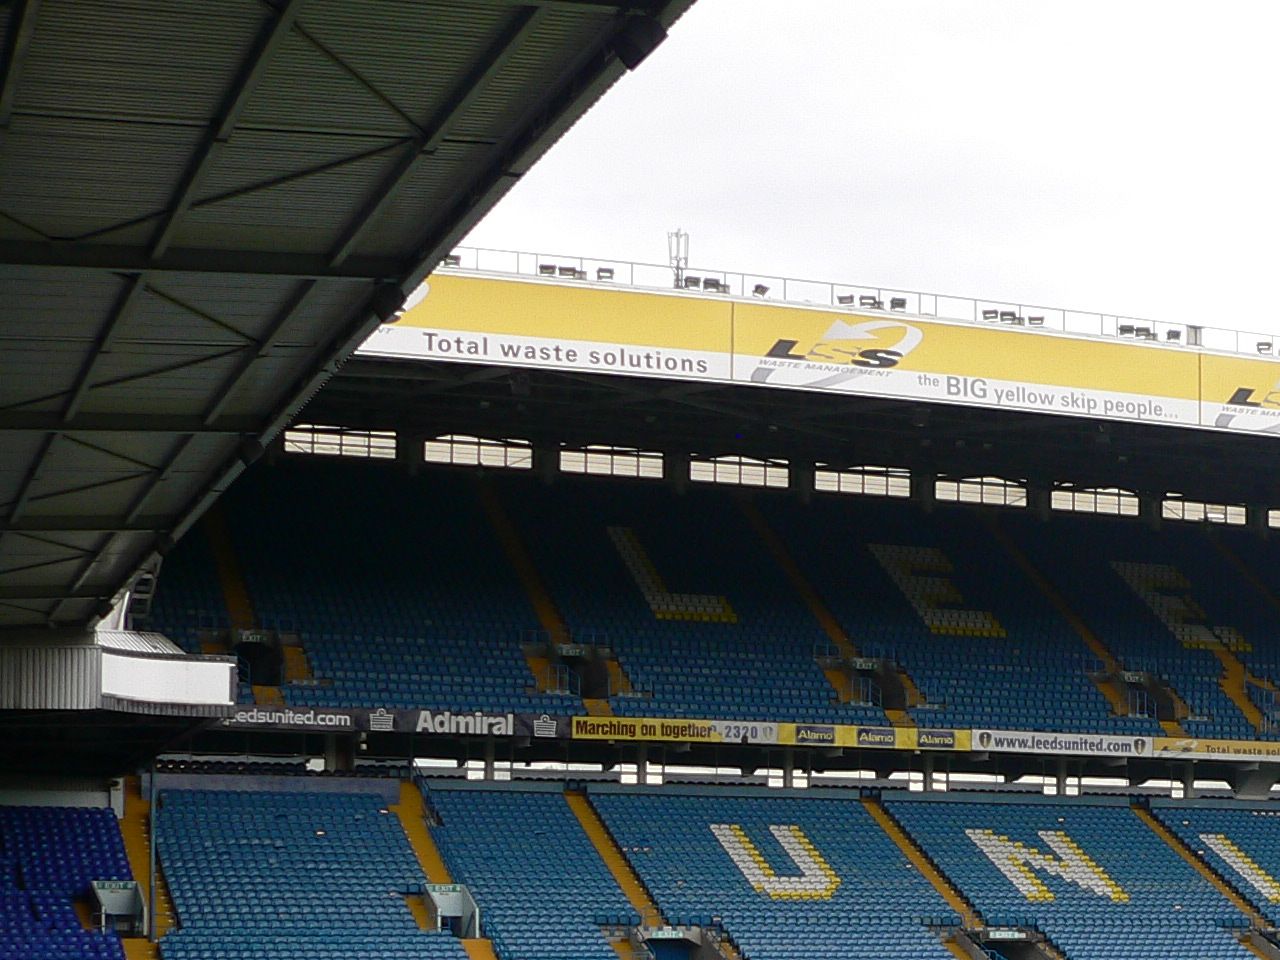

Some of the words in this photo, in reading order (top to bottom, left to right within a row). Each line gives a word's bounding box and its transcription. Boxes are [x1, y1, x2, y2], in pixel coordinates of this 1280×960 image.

[422, 332, 488, 356] Total
[500, 342, 578, 363] waste
[589, 349, 708, 373] solutions
[758, 359, 803, 369] WASTE
[805, 362, 893, 378] MANAGEMENT
[917, 374, 940, 388] the
[947, 376, 987, 399] BIG
[994, 386, 1055, 406] yellow
[1060, 391, 1098, 413] skip
[1221, 405, 1258, 415] WASTE
[232, 708, 350, 727] edsunited.com
[416, 709, 514, 736] Admiral
[575, 719, 636, 738] Marching
[641, 723, 657, 737] on
[661, 721, 712, 740] together
[798, 730, 833, 740] Alamo
[859, 733, 893, 743] Alamo
[919, 735, 953, 746] Alamo
[993, 735, 1132, 753] www.leedsunited.com
[1205, 745, 1230, 755] Total
